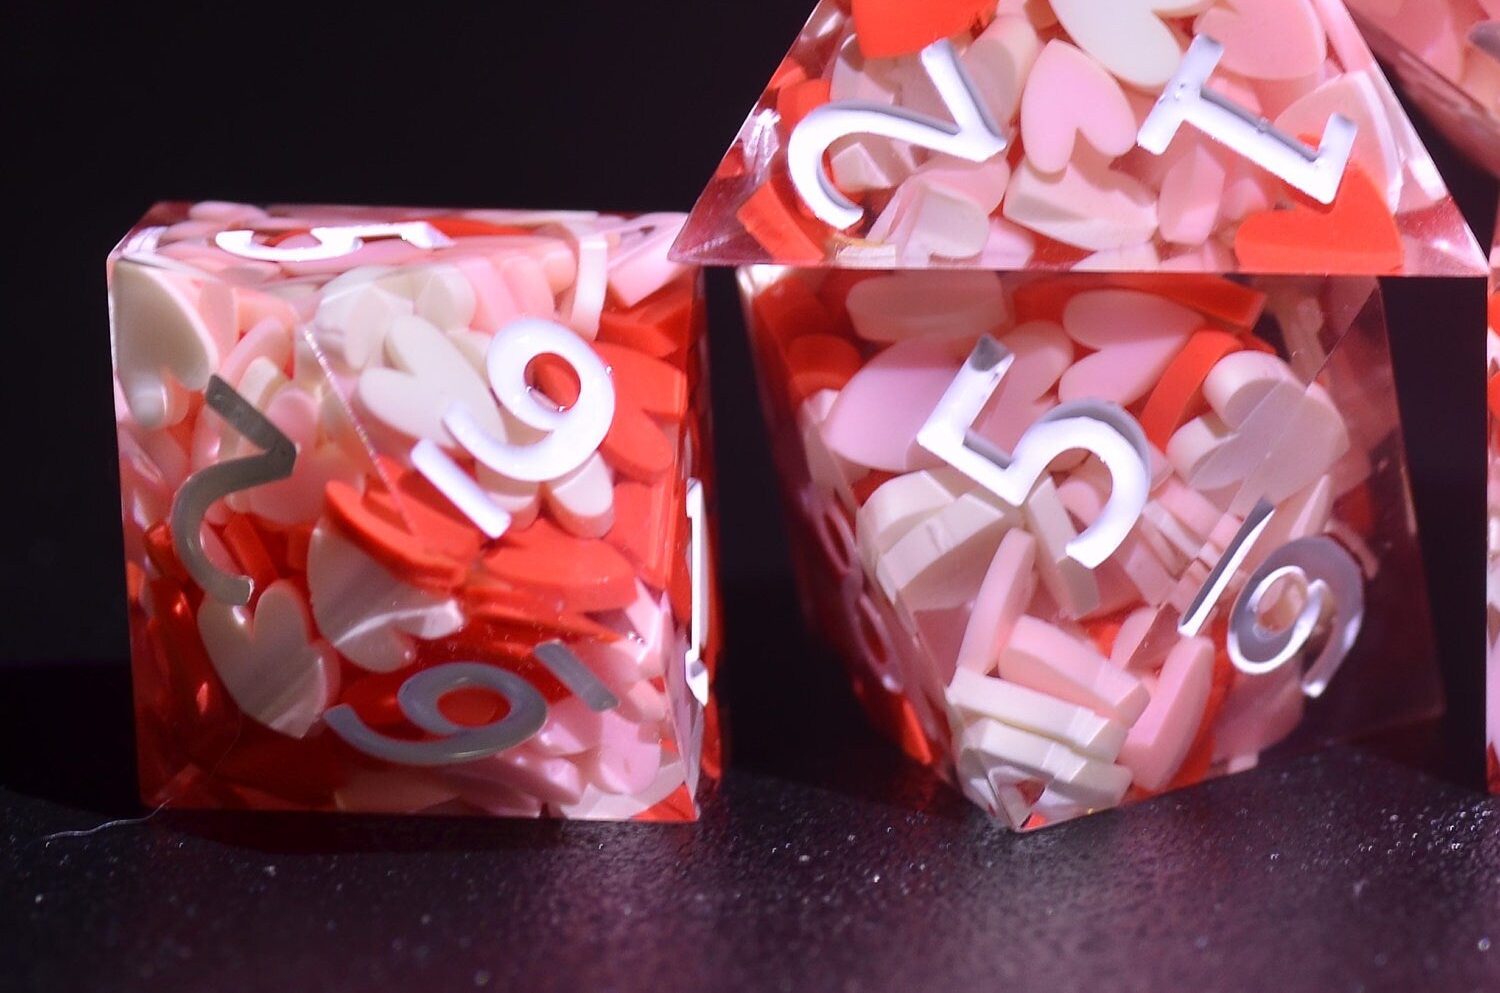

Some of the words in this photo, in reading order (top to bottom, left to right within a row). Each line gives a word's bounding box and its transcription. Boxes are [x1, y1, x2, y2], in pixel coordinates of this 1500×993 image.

[787, 39, 1006, 229] 2
[1137, 34, 1357, 205] 1
[917, 337, 1151, 569] 5
